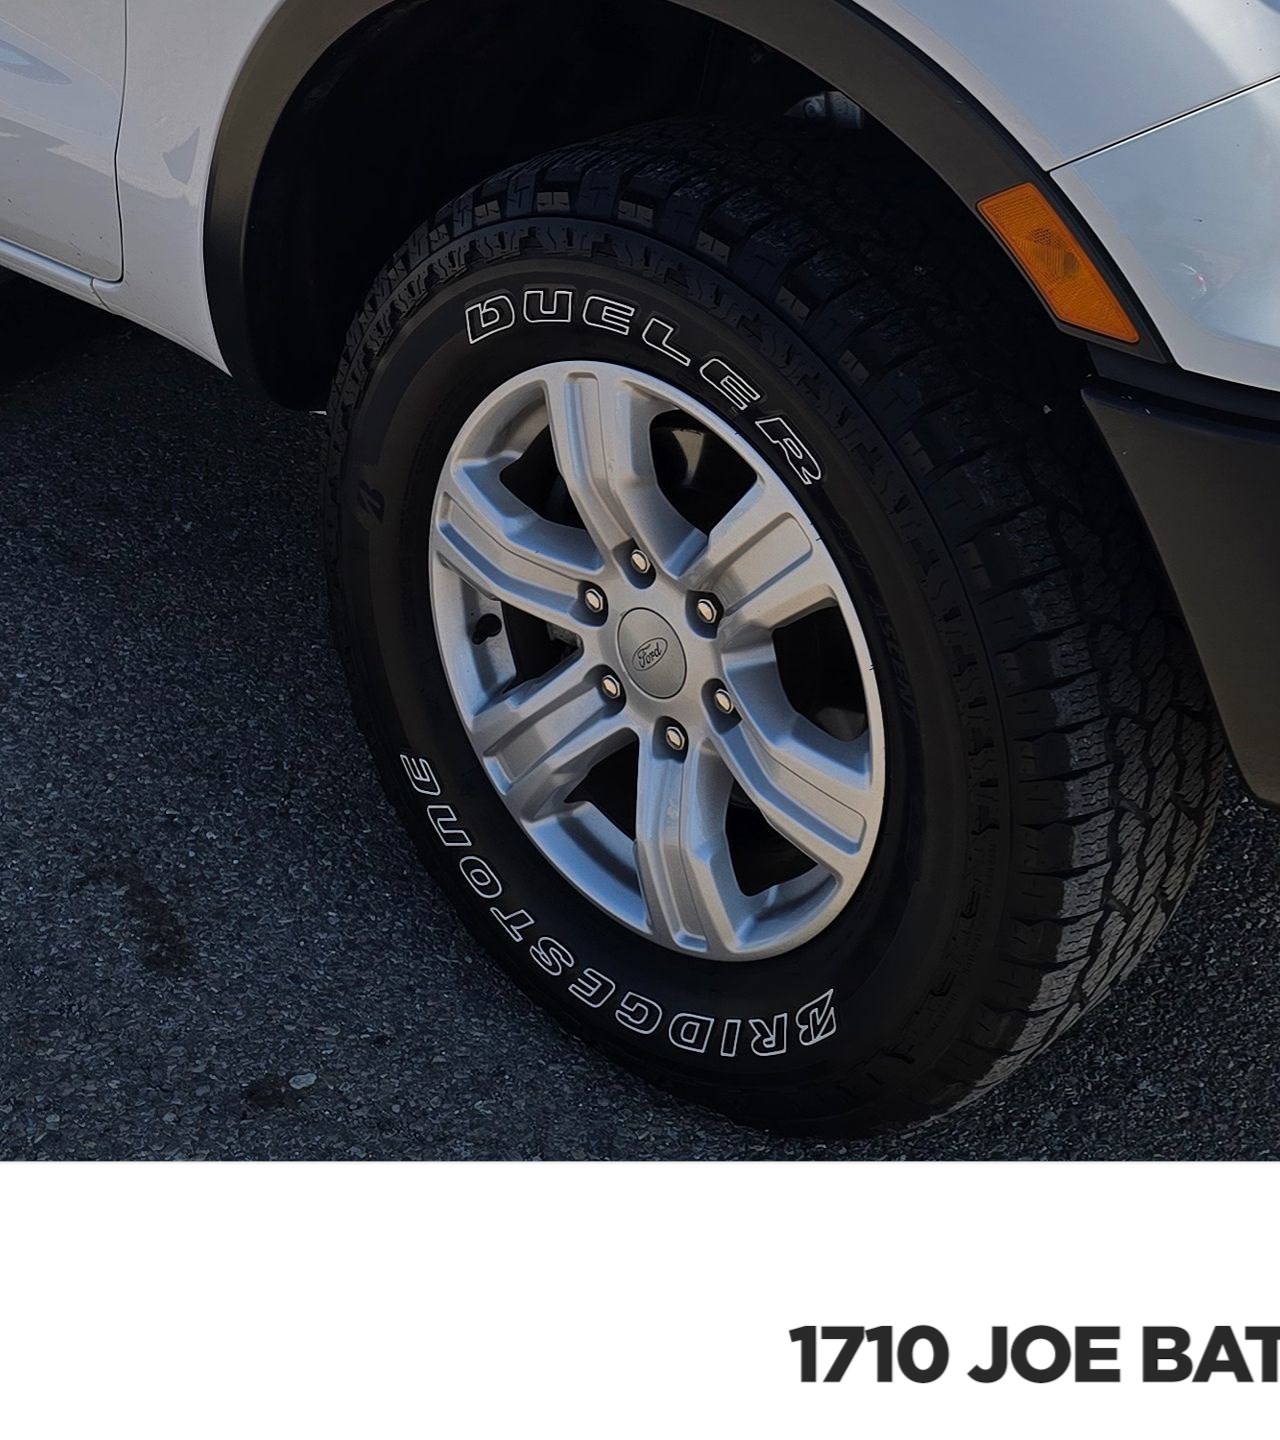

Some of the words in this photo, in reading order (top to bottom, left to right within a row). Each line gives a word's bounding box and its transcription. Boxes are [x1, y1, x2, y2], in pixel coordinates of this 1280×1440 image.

[464, 286, 826, 489] DUELER
[636, 641, 663, 668] Ford
[399, 752, 840, 1059] BRIDGESTONE
